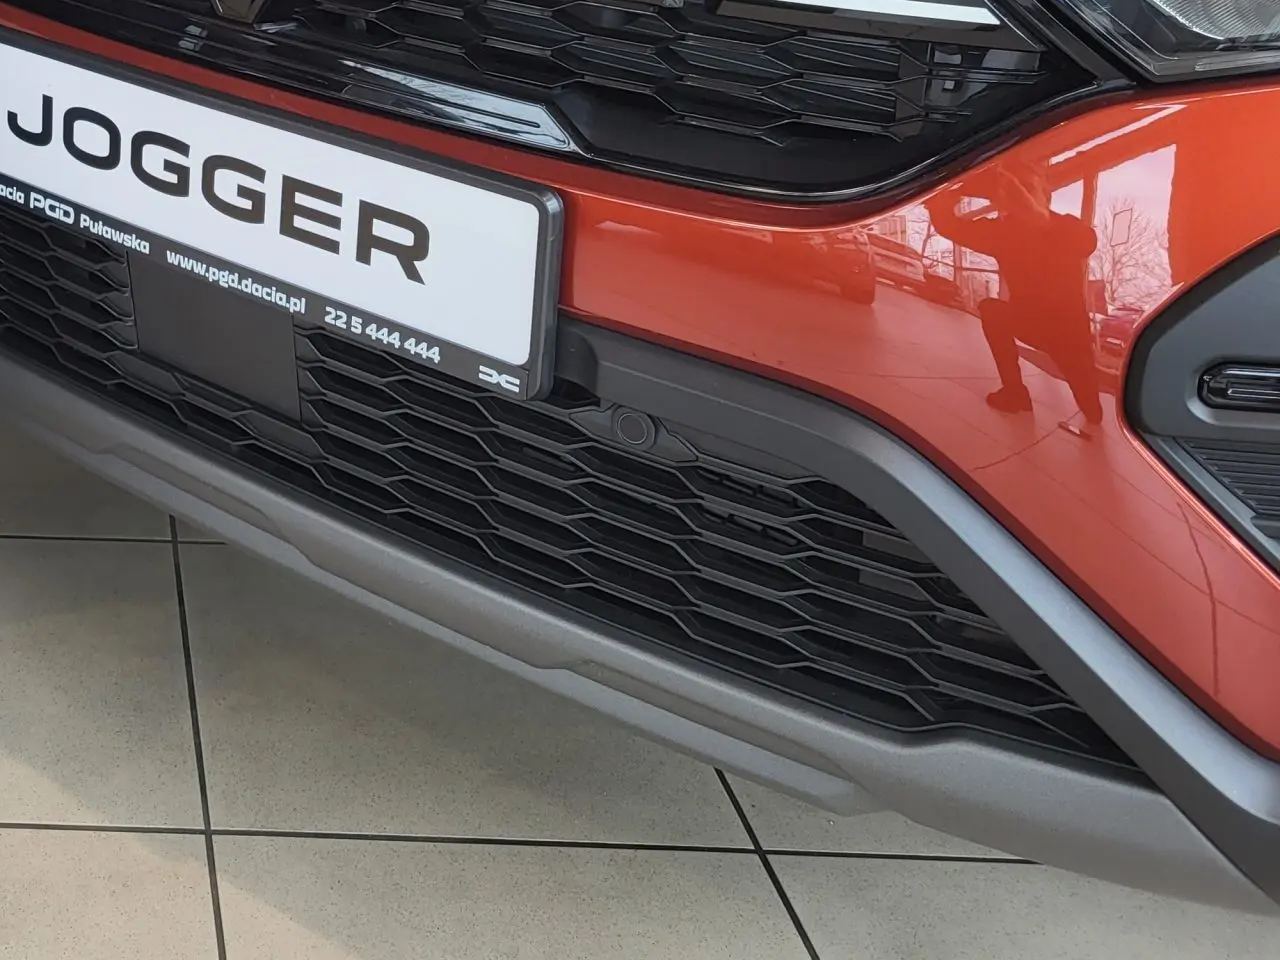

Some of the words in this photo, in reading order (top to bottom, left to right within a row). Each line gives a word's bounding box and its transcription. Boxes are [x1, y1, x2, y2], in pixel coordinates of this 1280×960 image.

[7, 93, 430, 285] JOGGER
[29, 192, 75, 225] PGD
[80, 213, 150, 255] Puławska
[166, 250, 306, 315] www.pgd.dacia.pl
[324, 306, 347, 330] 22
[350, 315, 362, 335] 5
[365, 323, 401, 349] 444
[403, 337, 441, 364] 444
